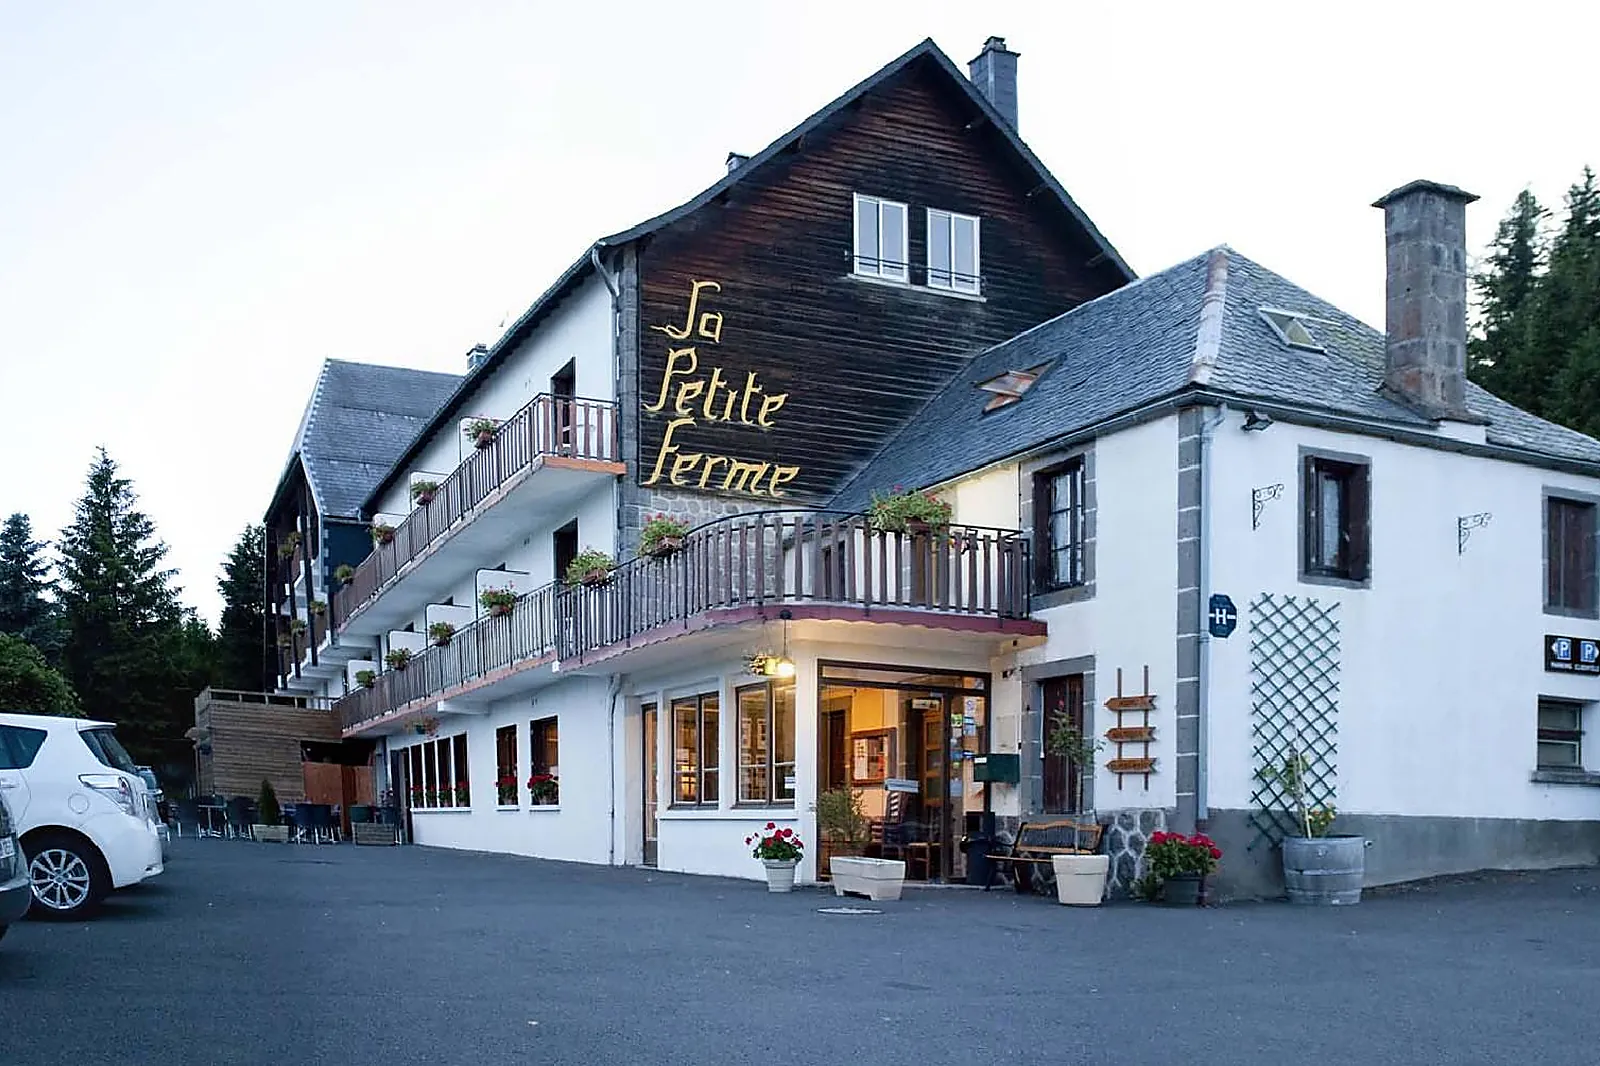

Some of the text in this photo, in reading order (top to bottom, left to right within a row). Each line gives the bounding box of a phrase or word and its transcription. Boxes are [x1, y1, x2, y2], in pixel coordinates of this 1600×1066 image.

[642, 346, 789, 428] Petite
[640, 416, 800, 497] Ferme
[1215, 608, 1227, 625] H
[1560, 641, 1594, 660] P P
